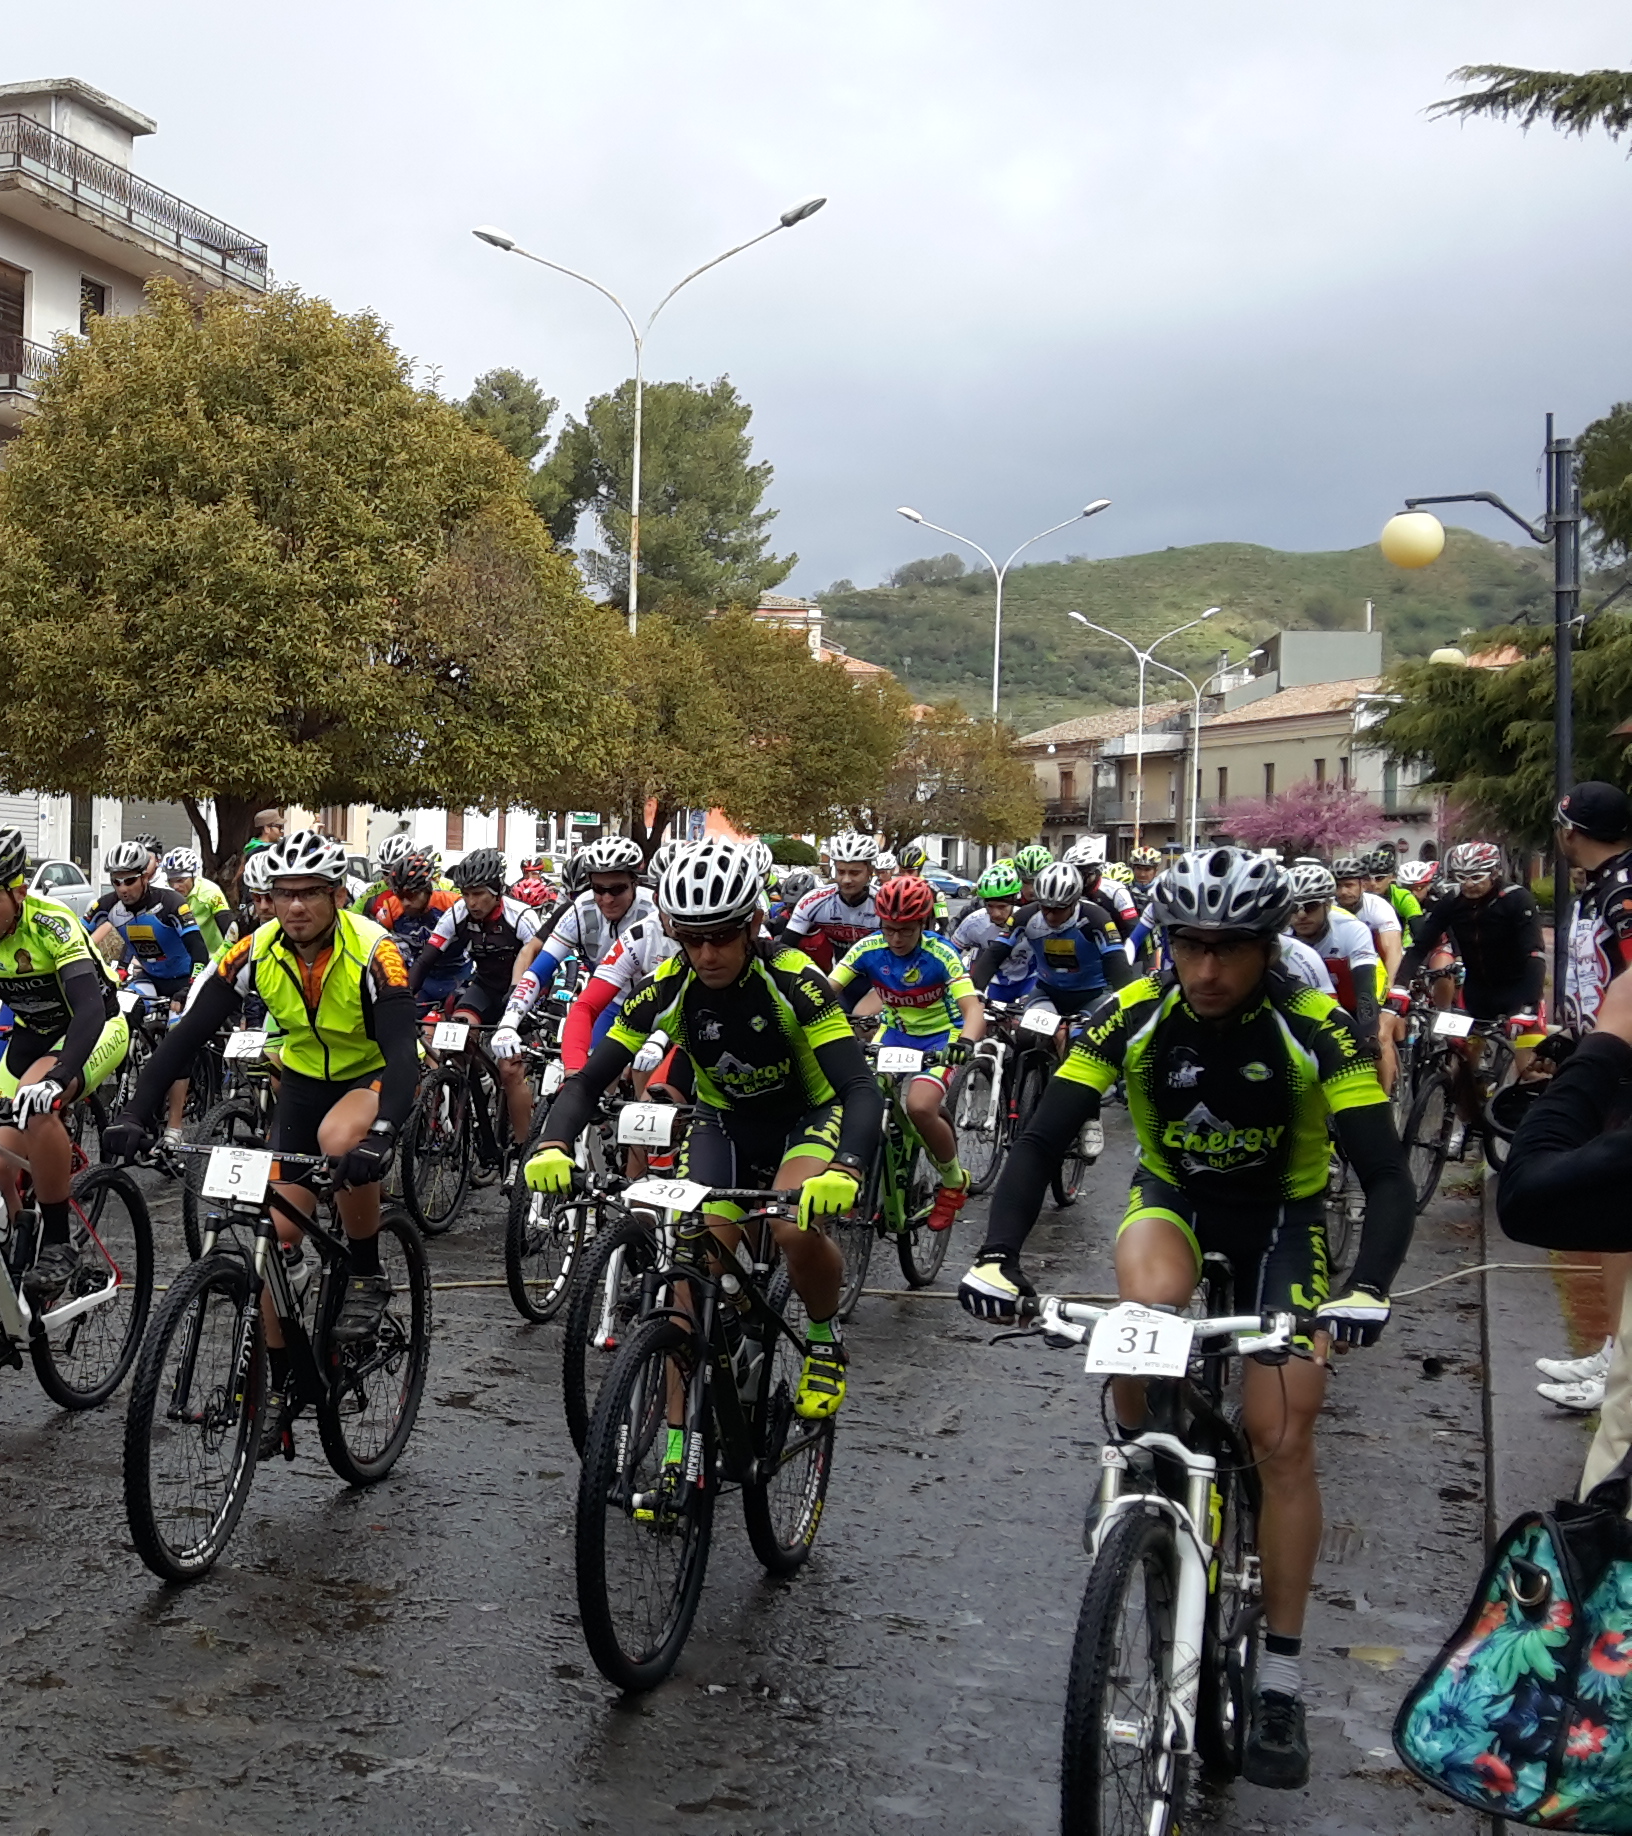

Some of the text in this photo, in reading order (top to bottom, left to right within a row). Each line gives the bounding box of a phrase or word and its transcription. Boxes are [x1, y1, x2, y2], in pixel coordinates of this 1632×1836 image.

[34, 912, 71, 944] BETTER
[623, 985, 659, 1016] Energy
[800, 979, 825, 1007] bike
[1032, 1015, 1049, 1027] 46
[239, 1037, 256, 1051] 22
[443, 1031, 458, 1043] 11
[1331, 1028, 1358, 1059] bike
[883, 1050, 916, 1065] 218
[634, 1114, 658, 1133] 21
[1162, 1121, 1285, 1154] Energy
[1208, 1152, 1247, 1168] bike
[228, 1164, 244, 1185] 5
[649, 1184, 687, 1201] 30
[1117, 1326, 1162, 1356] 31
[685, 1430, 703, 1483] ROCKSHOX
